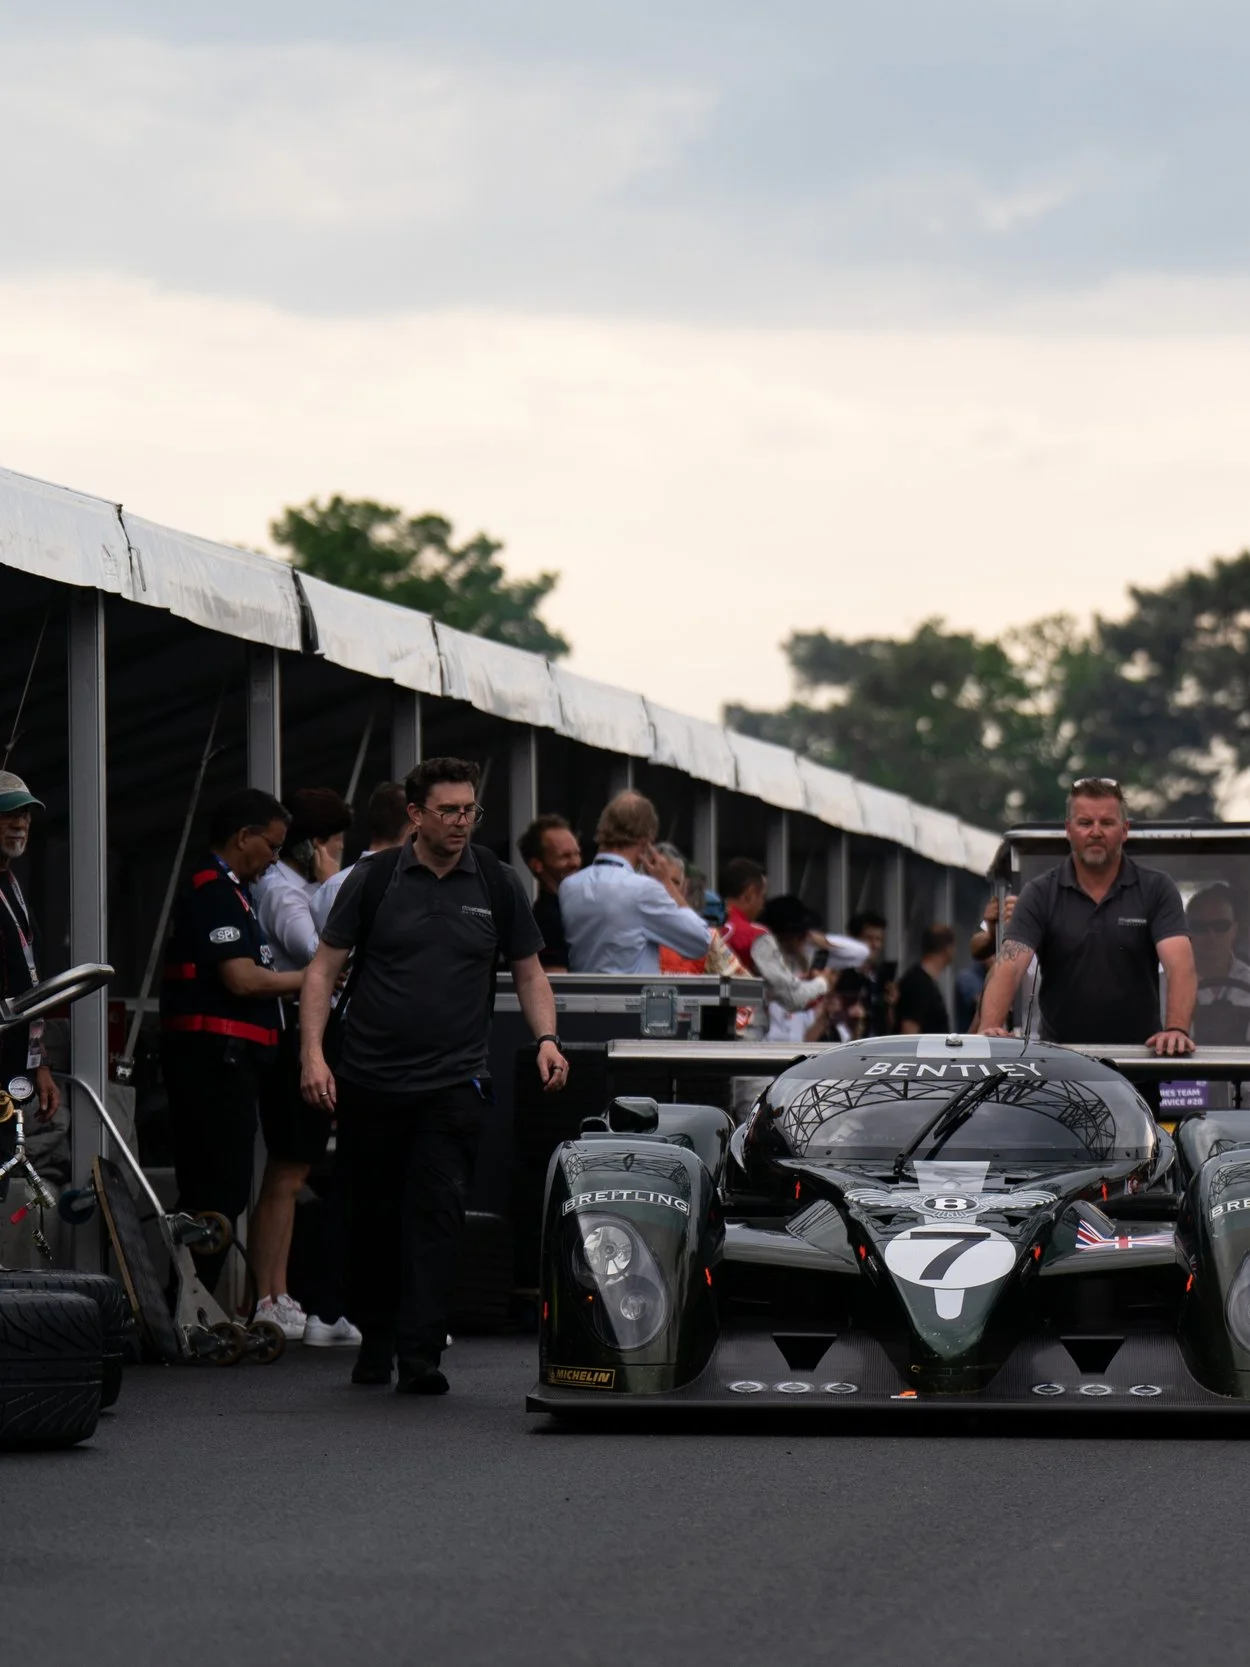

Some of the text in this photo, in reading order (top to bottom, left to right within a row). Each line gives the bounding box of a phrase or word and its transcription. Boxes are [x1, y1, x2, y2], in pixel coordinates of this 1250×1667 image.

[864, 1062, 1042, 1077] BENTLEY
[1177, 1088, 1201, 1097] TEAM
[564, 1190, 688, 1212] BREITLING
[910, 1231, 991, 1280] 7
[556, 1369, 610, 1383] MICHELIN
